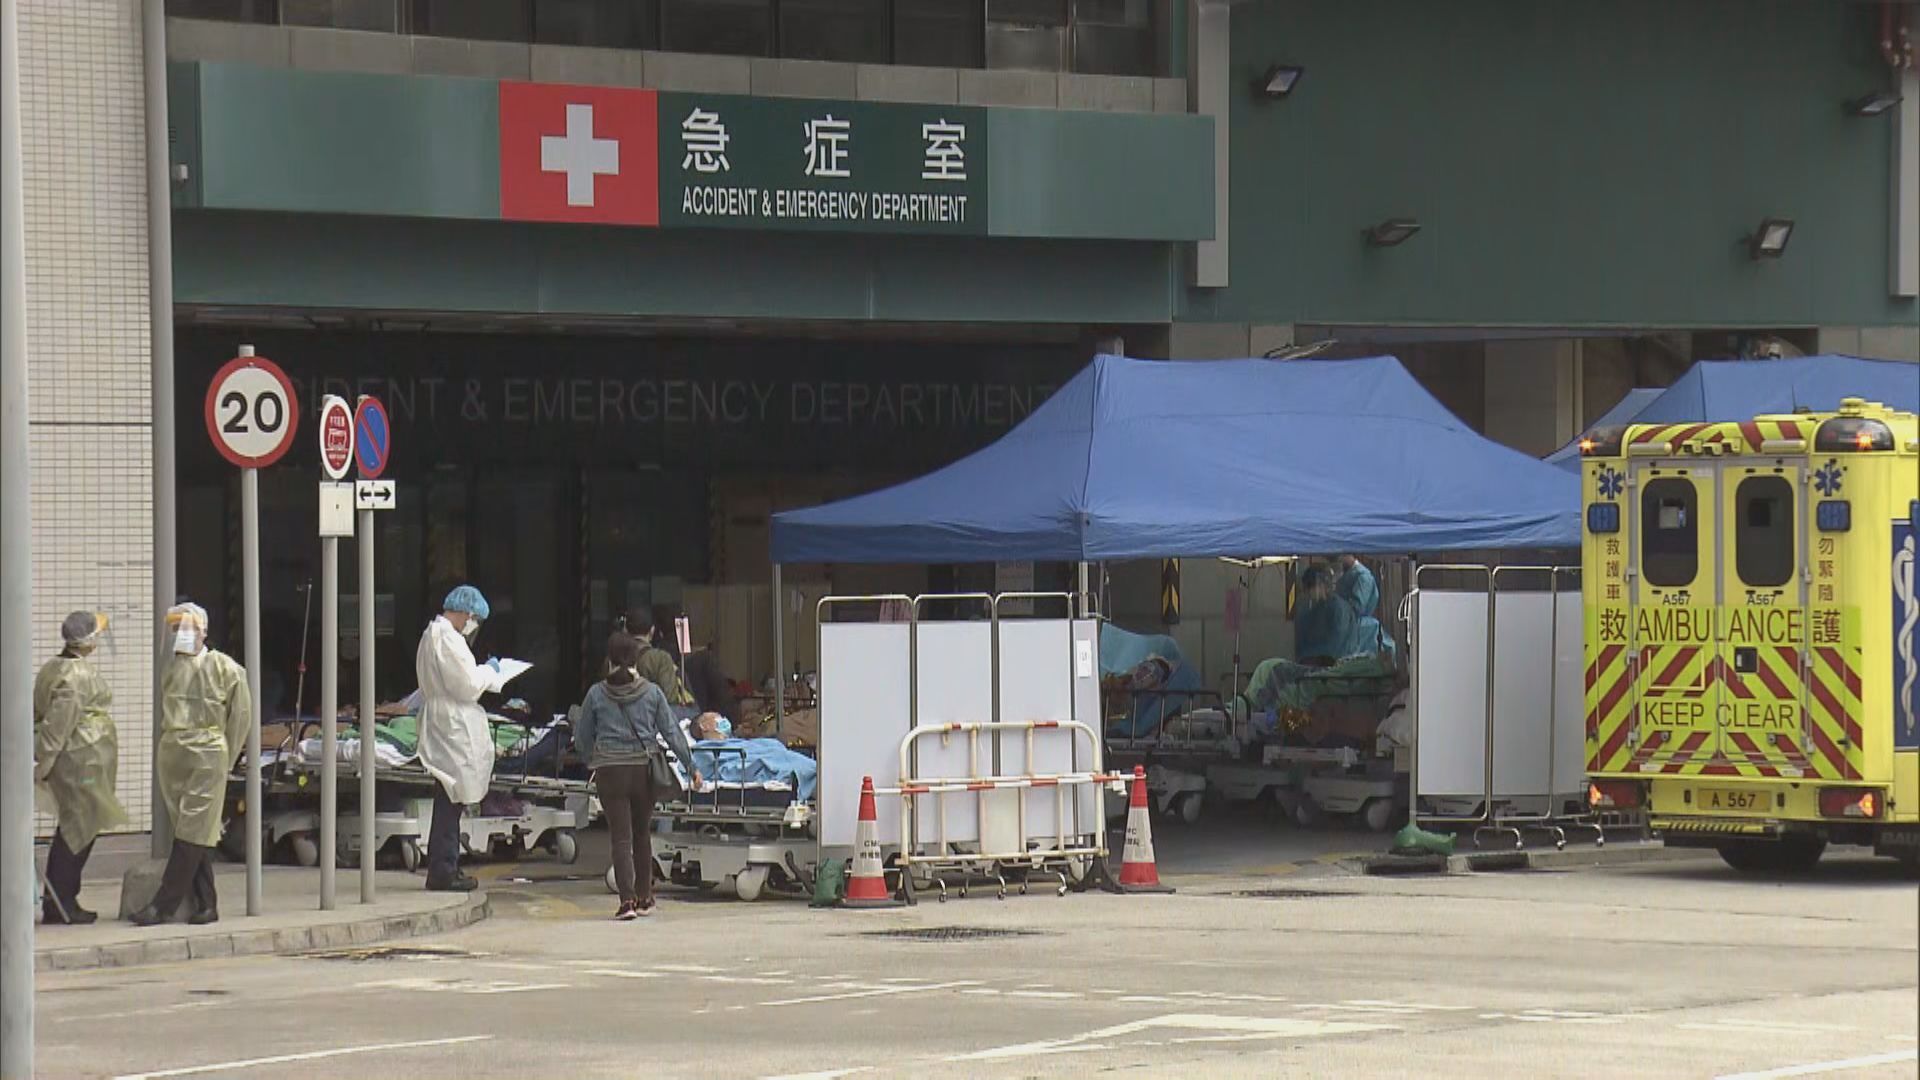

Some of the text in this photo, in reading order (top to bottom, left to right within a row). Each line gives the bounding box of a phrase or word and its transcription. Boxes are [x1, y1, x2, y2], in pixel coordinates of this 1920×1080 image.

[681, 107, 967, 181] 急症室
[682, 186, 967, 223] ACCIDENT & EMERGENCY DEPARTMENT
[221, 392, 284, 434] 20
[461, 378, 488, 421] &
[504, 377, 775, 424] EMERGENCY
[1662, 594, 1691, 605] A567
[1747, 594, 1777, 605] A567
[1600, 608, 1627, 641] 救
[1635, 608, 1803, 643] AMBULANCE
[1812, 608, 1841, 643] 護
[1644, 702, 1795, 729] KEEP CLEAR
[1711, 792, 1756, 807] A 567
